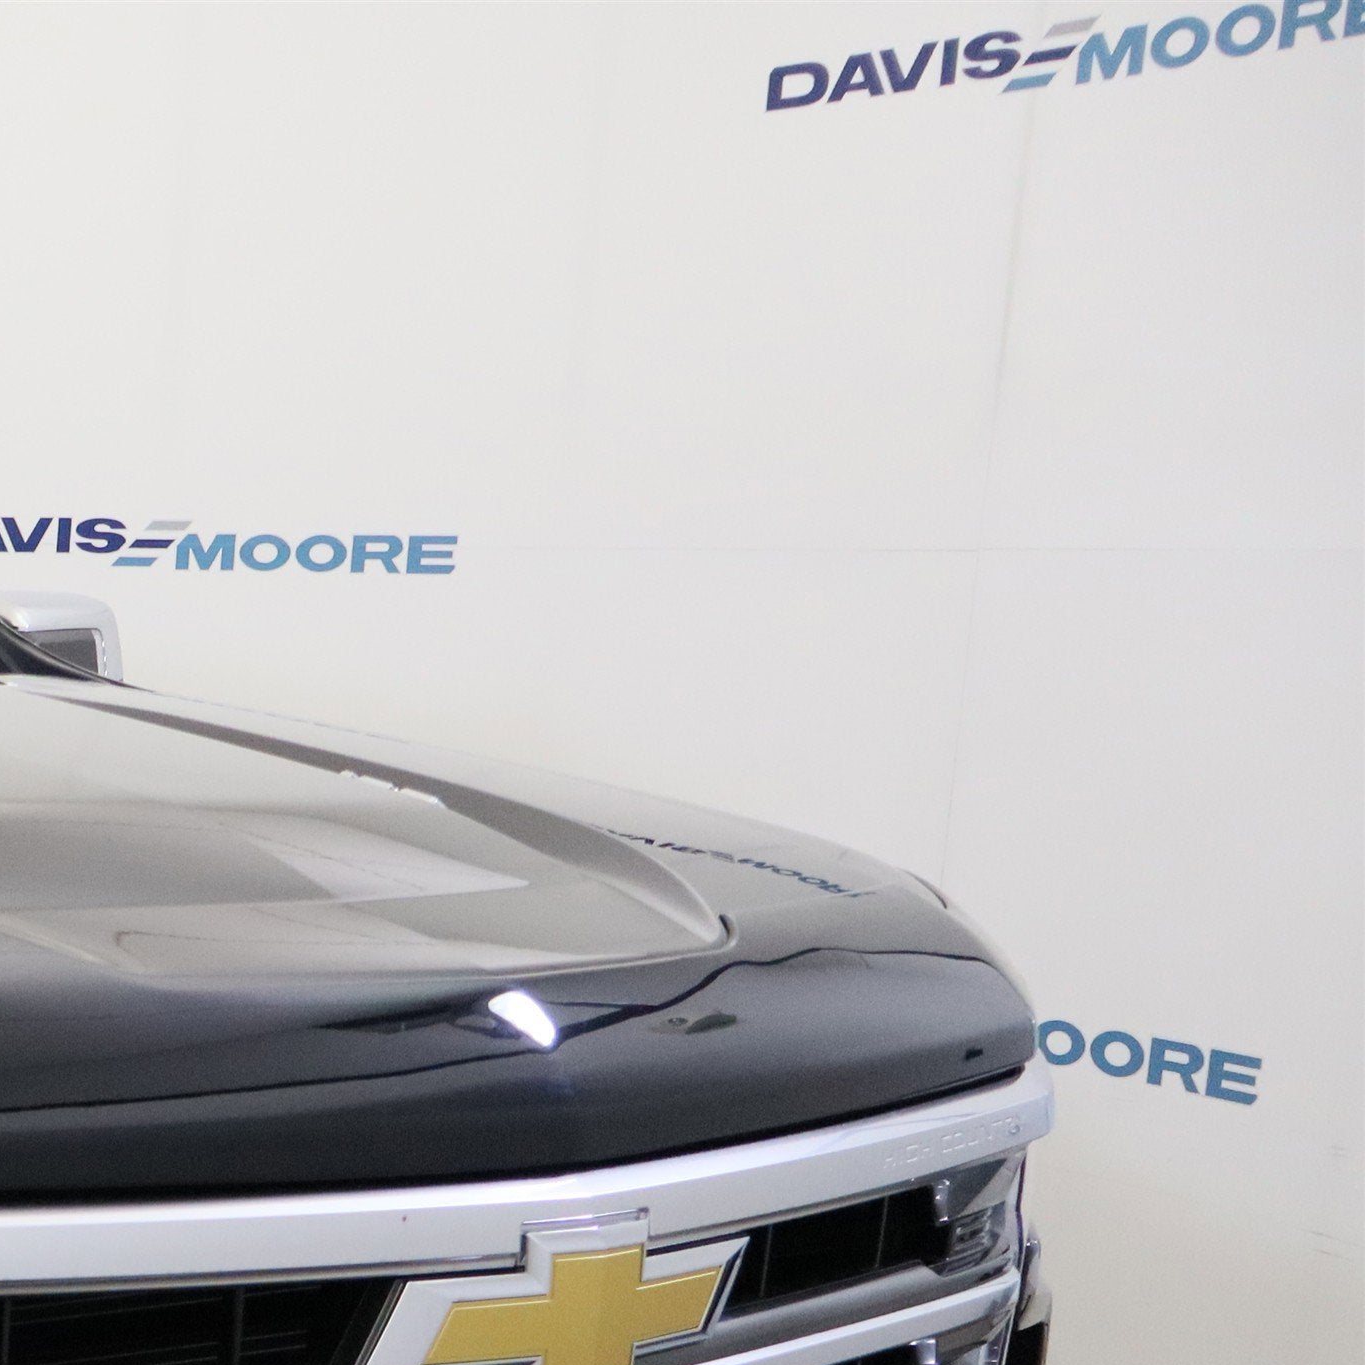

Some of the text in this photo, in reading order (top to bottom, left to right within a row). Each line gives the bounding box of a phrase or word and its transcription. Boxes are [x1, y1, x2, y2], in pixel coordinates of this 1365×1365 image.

[766, 30, 1021, 111] DAVIS
[175, 533, 458, 575] MOORE
[1037, 1019, 1263, 1106] OORE
